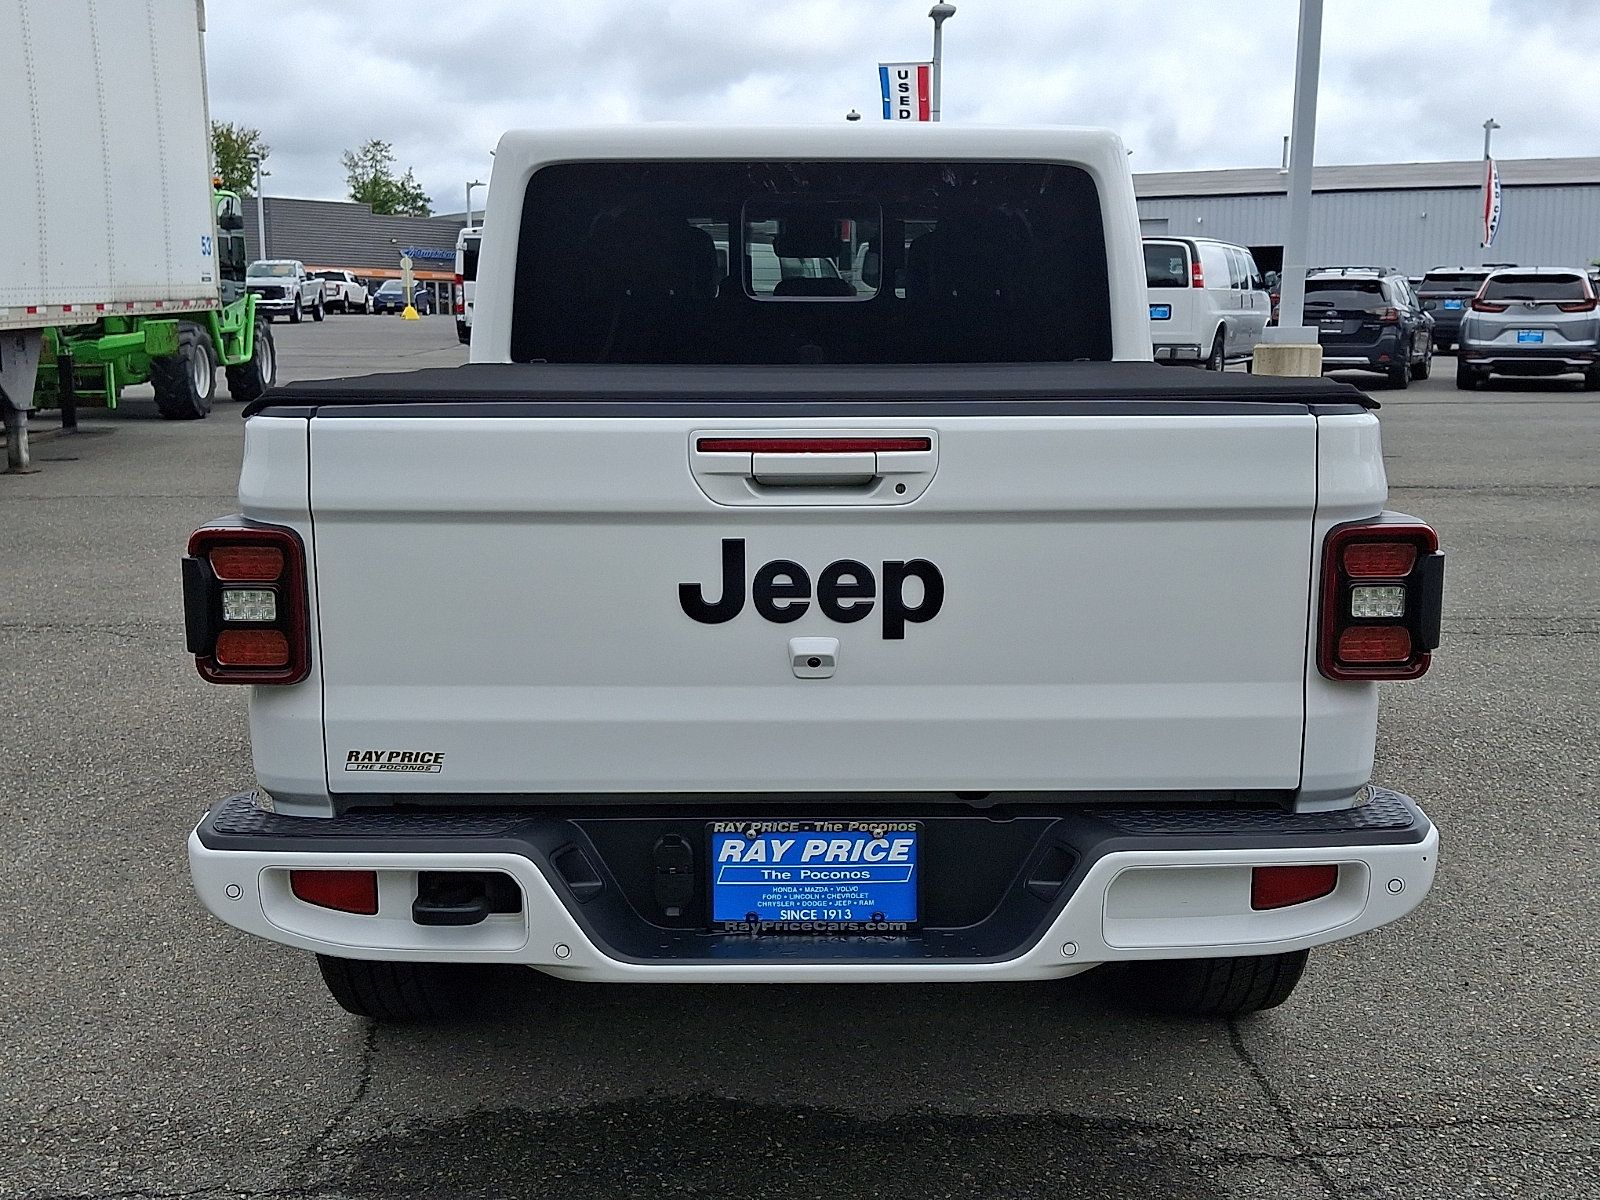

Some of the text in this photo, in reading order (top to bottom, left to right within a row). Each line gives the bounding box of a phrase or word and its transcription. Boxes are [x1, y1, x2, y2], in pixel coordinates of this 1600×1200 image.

[897, 70, 911, 120] USED
[201, 236, 212, 256] 53
[678, 538, 945, 640] Jeep
[346, 750, 445, 764] RAY PRICE
[713, 821, 917, 833] RAY PRICE The Poconos
[718, 838, 914, 863] RAY PRICE
[761, 869, 871, 880] The Poconos
[780, 908, 852, 920] SINCE 1913
[724, 920, 907, 935] RayPriceCars.com
